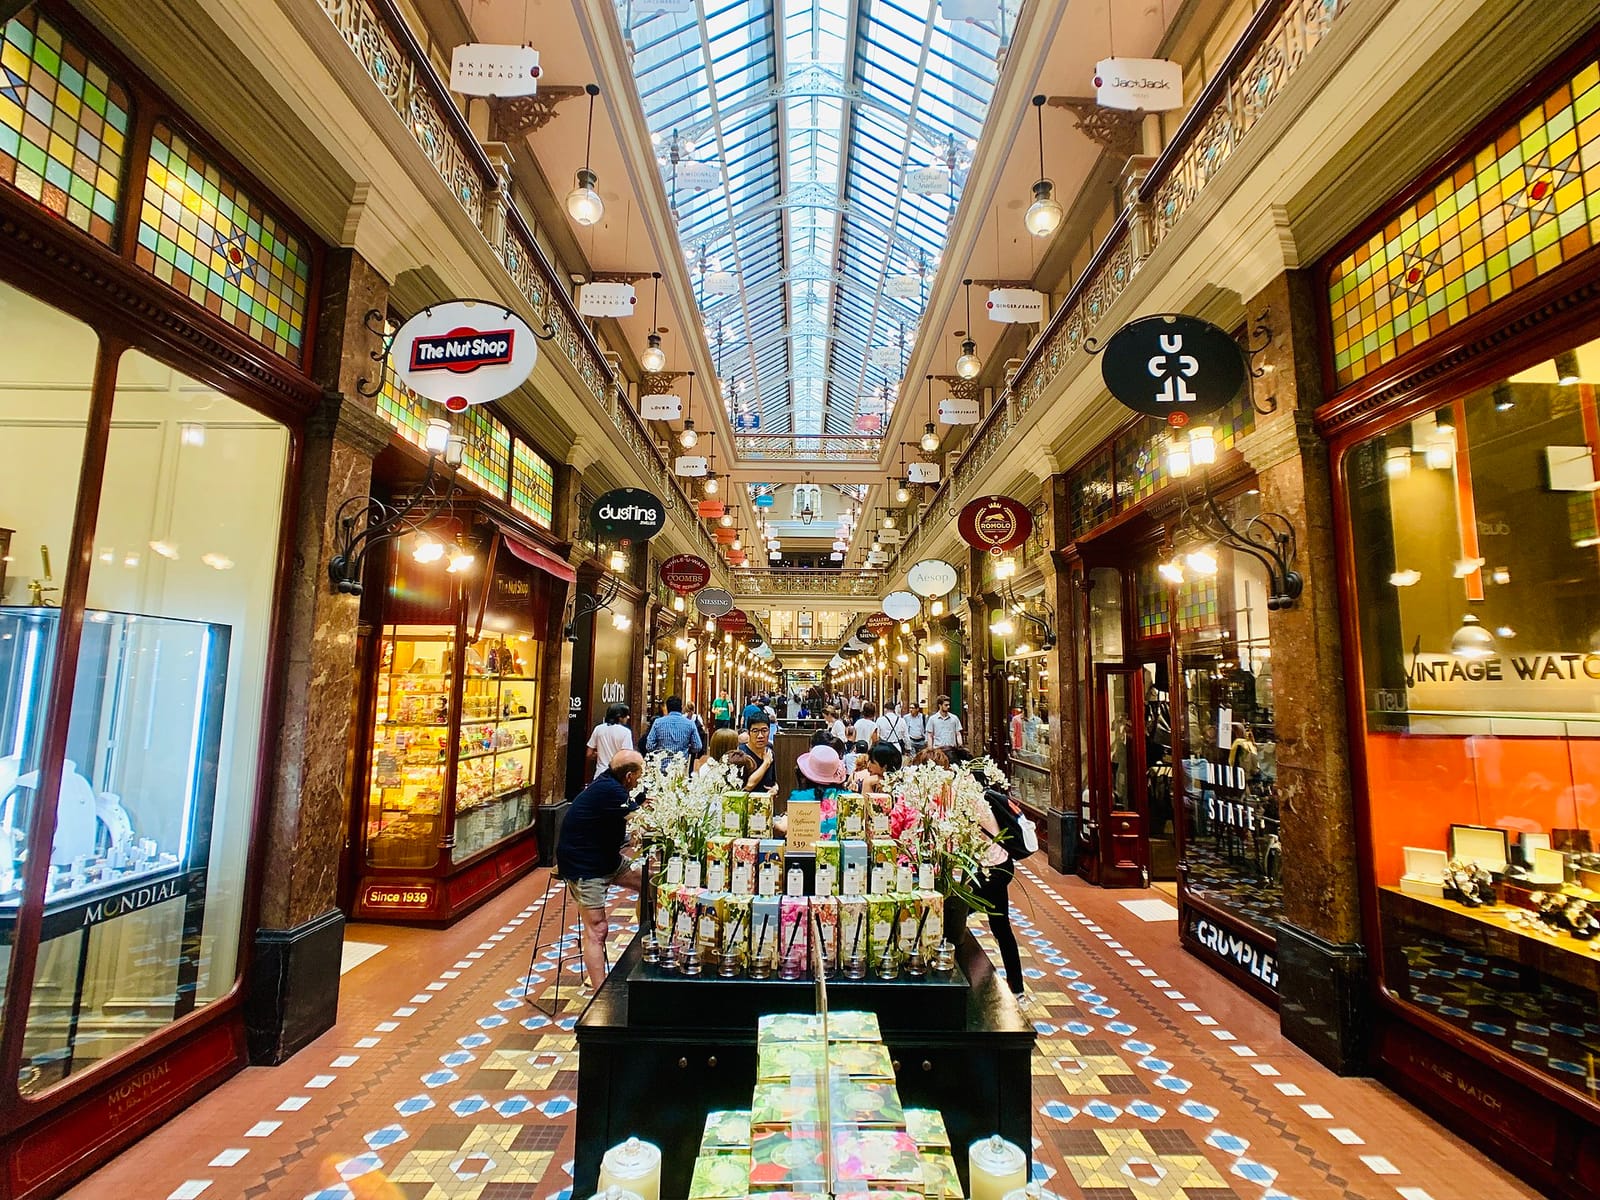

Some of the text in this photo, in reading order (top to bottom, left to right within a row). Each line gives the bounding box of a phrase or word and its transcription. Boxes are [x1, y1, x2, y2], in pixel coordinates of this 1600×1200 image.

[458, 61, 495, 70] SKIN
[457, 70, 523, 79] THREADS
[418, 338, 508, 361] The Nut Shop
[1171, 413, 1184, 424] 26
[598, 503, 657, 521] dustins
[667, 574, 703, 583] COOMBS
[917, 573, 949, 584] Aesop
[1404, 644, 1504, 686] VINTAGE
[1206, 762, 1246, 790] MIND
[83, 881, 178, 926] MONDIAL
[370, 891, 428, 903] Since 1939
[108, 1061, 170, 1107] MONDIAL
